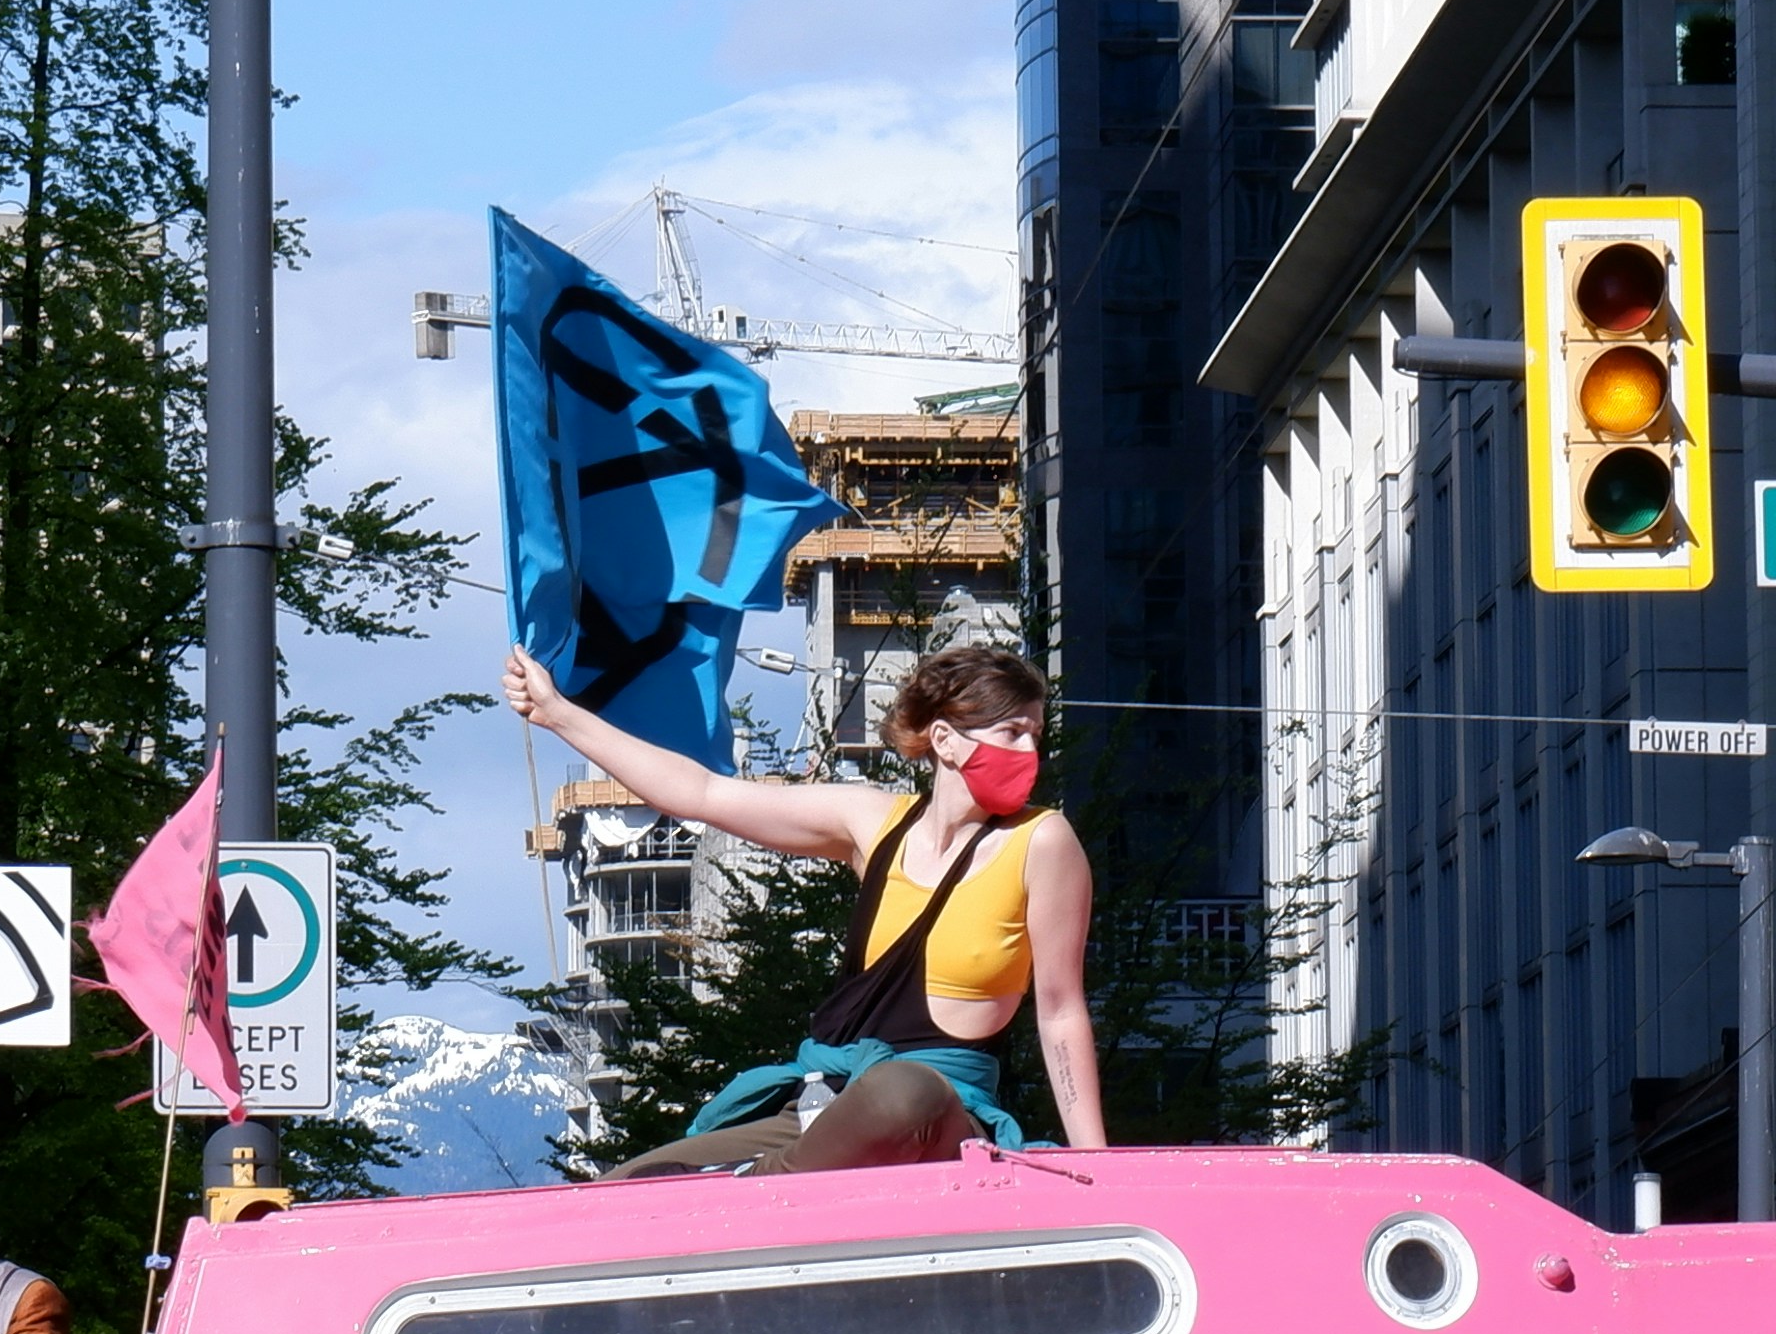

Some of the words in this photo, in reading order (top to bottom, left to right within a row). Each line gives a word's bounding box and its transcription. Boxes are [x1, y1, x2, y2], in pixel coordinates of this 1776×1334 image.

[1638, 729, 1709, 753] POWER
[1720, 731, 1757, 754] OFF
[230, 1026, 305, 1053] CEPT
